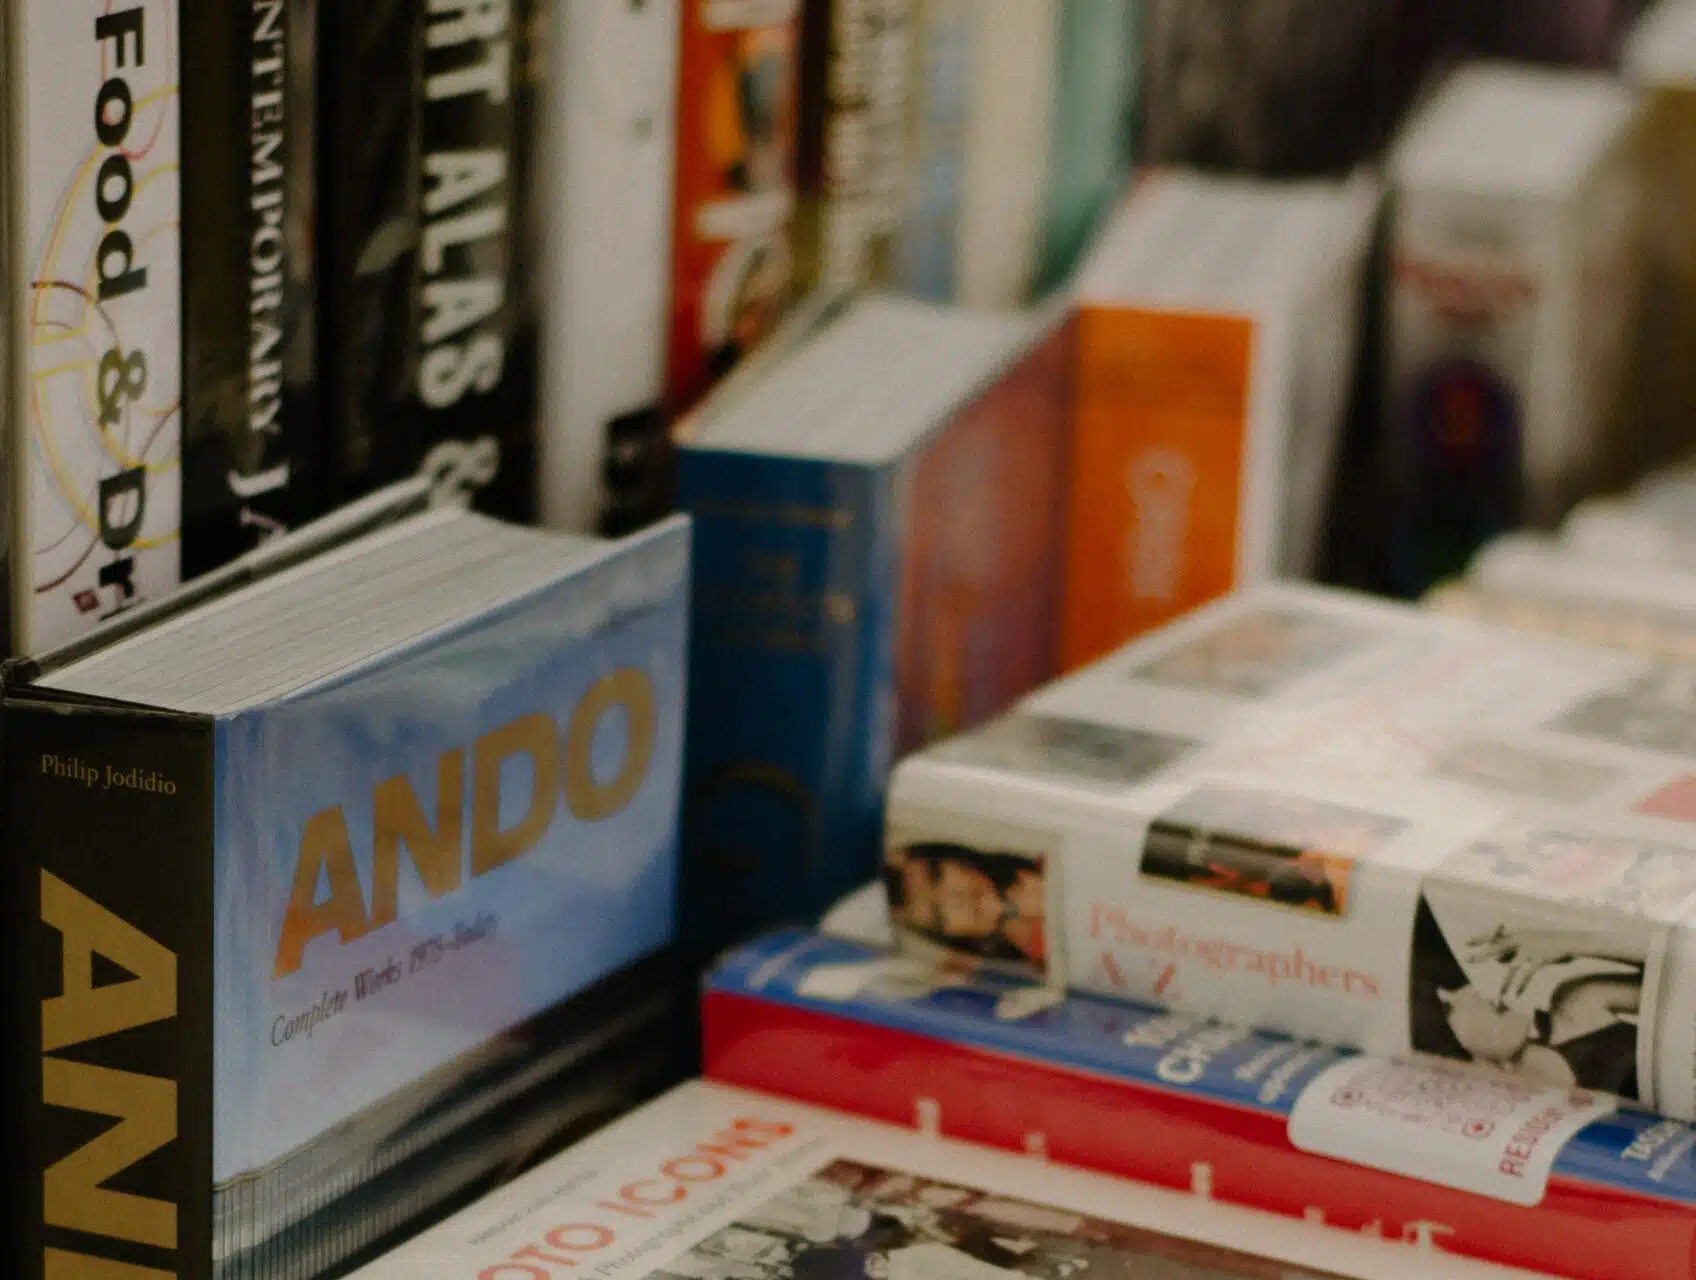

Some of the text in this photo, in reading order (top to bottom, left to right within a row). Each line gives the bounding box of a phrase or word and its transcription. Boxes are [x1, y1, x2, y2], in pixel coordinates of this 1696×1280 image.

[95, 5, 147, 302] Food
[419, 147, 508, 410] ALAS
[96, 349, 148, 430] &
[41, 753, 177, 796] Philip Jodidio
[272, 666, 656, 981] ANDO
[1089, 903, 1384, 998] Photographers
[597, 1116, 795, 1218] ICONS
